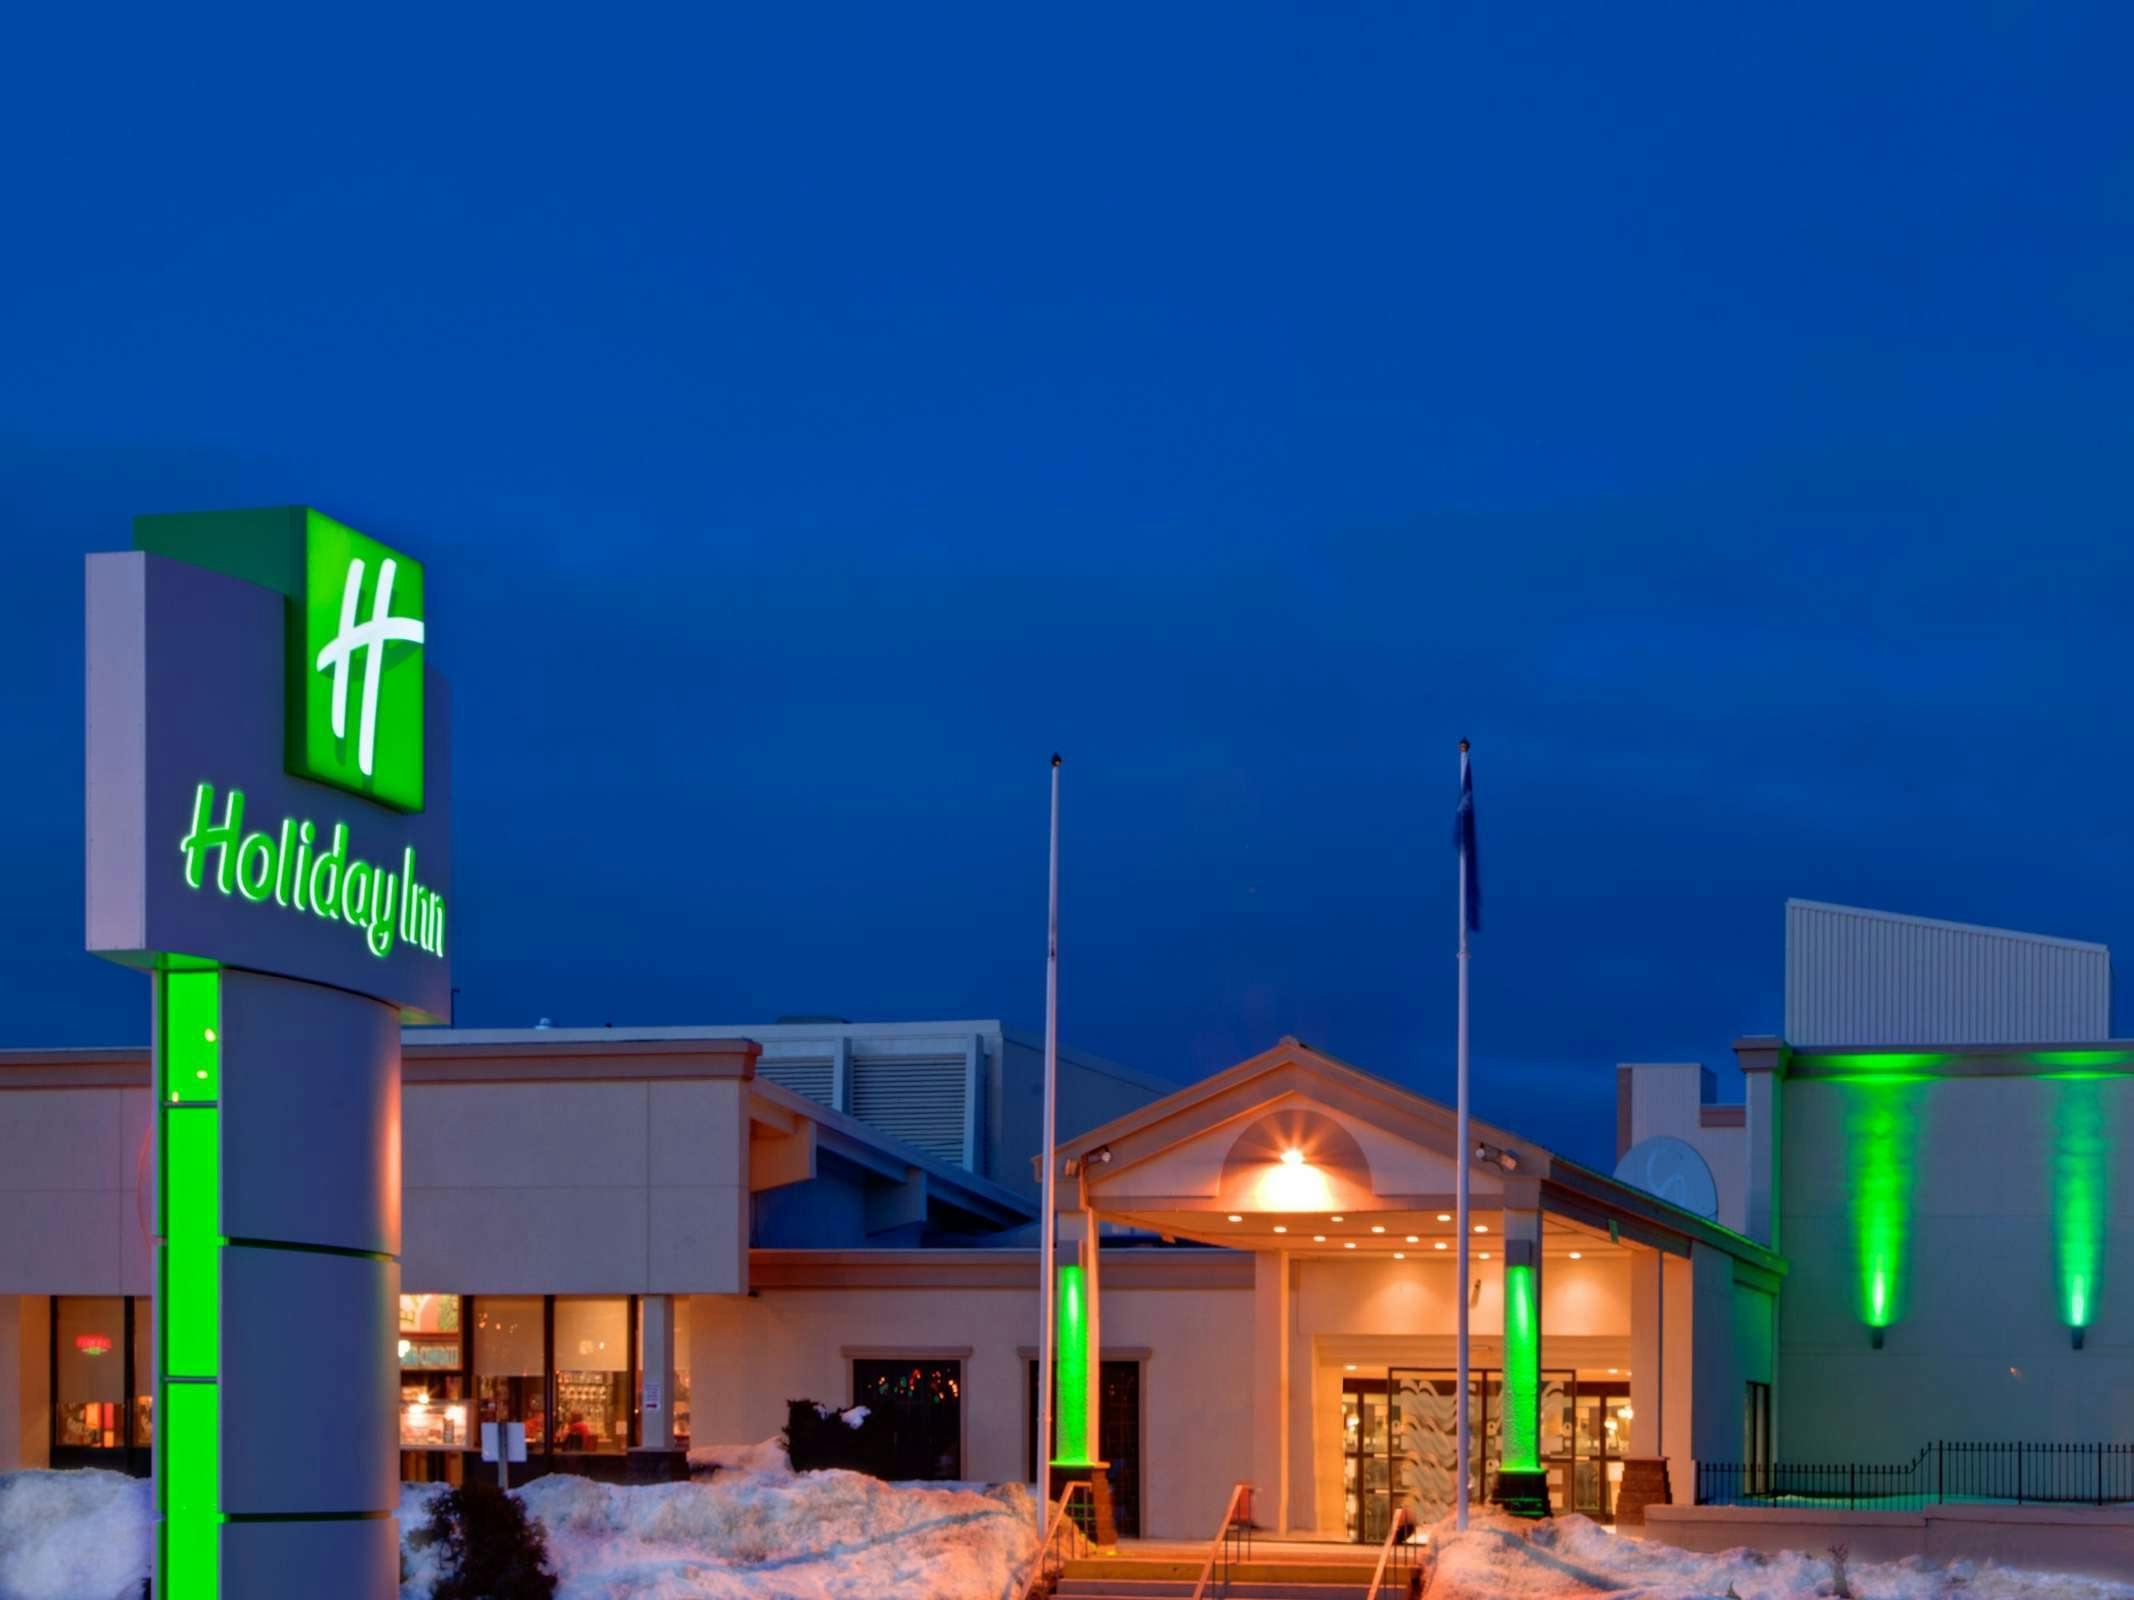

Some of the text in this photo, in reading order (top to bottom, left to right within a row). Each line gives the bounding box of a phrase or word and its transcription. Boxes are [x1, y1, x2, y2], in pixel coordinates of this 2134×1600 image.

[316, 558, 425, 776] H
[181, 783, 446, 958] Holiday Inn
